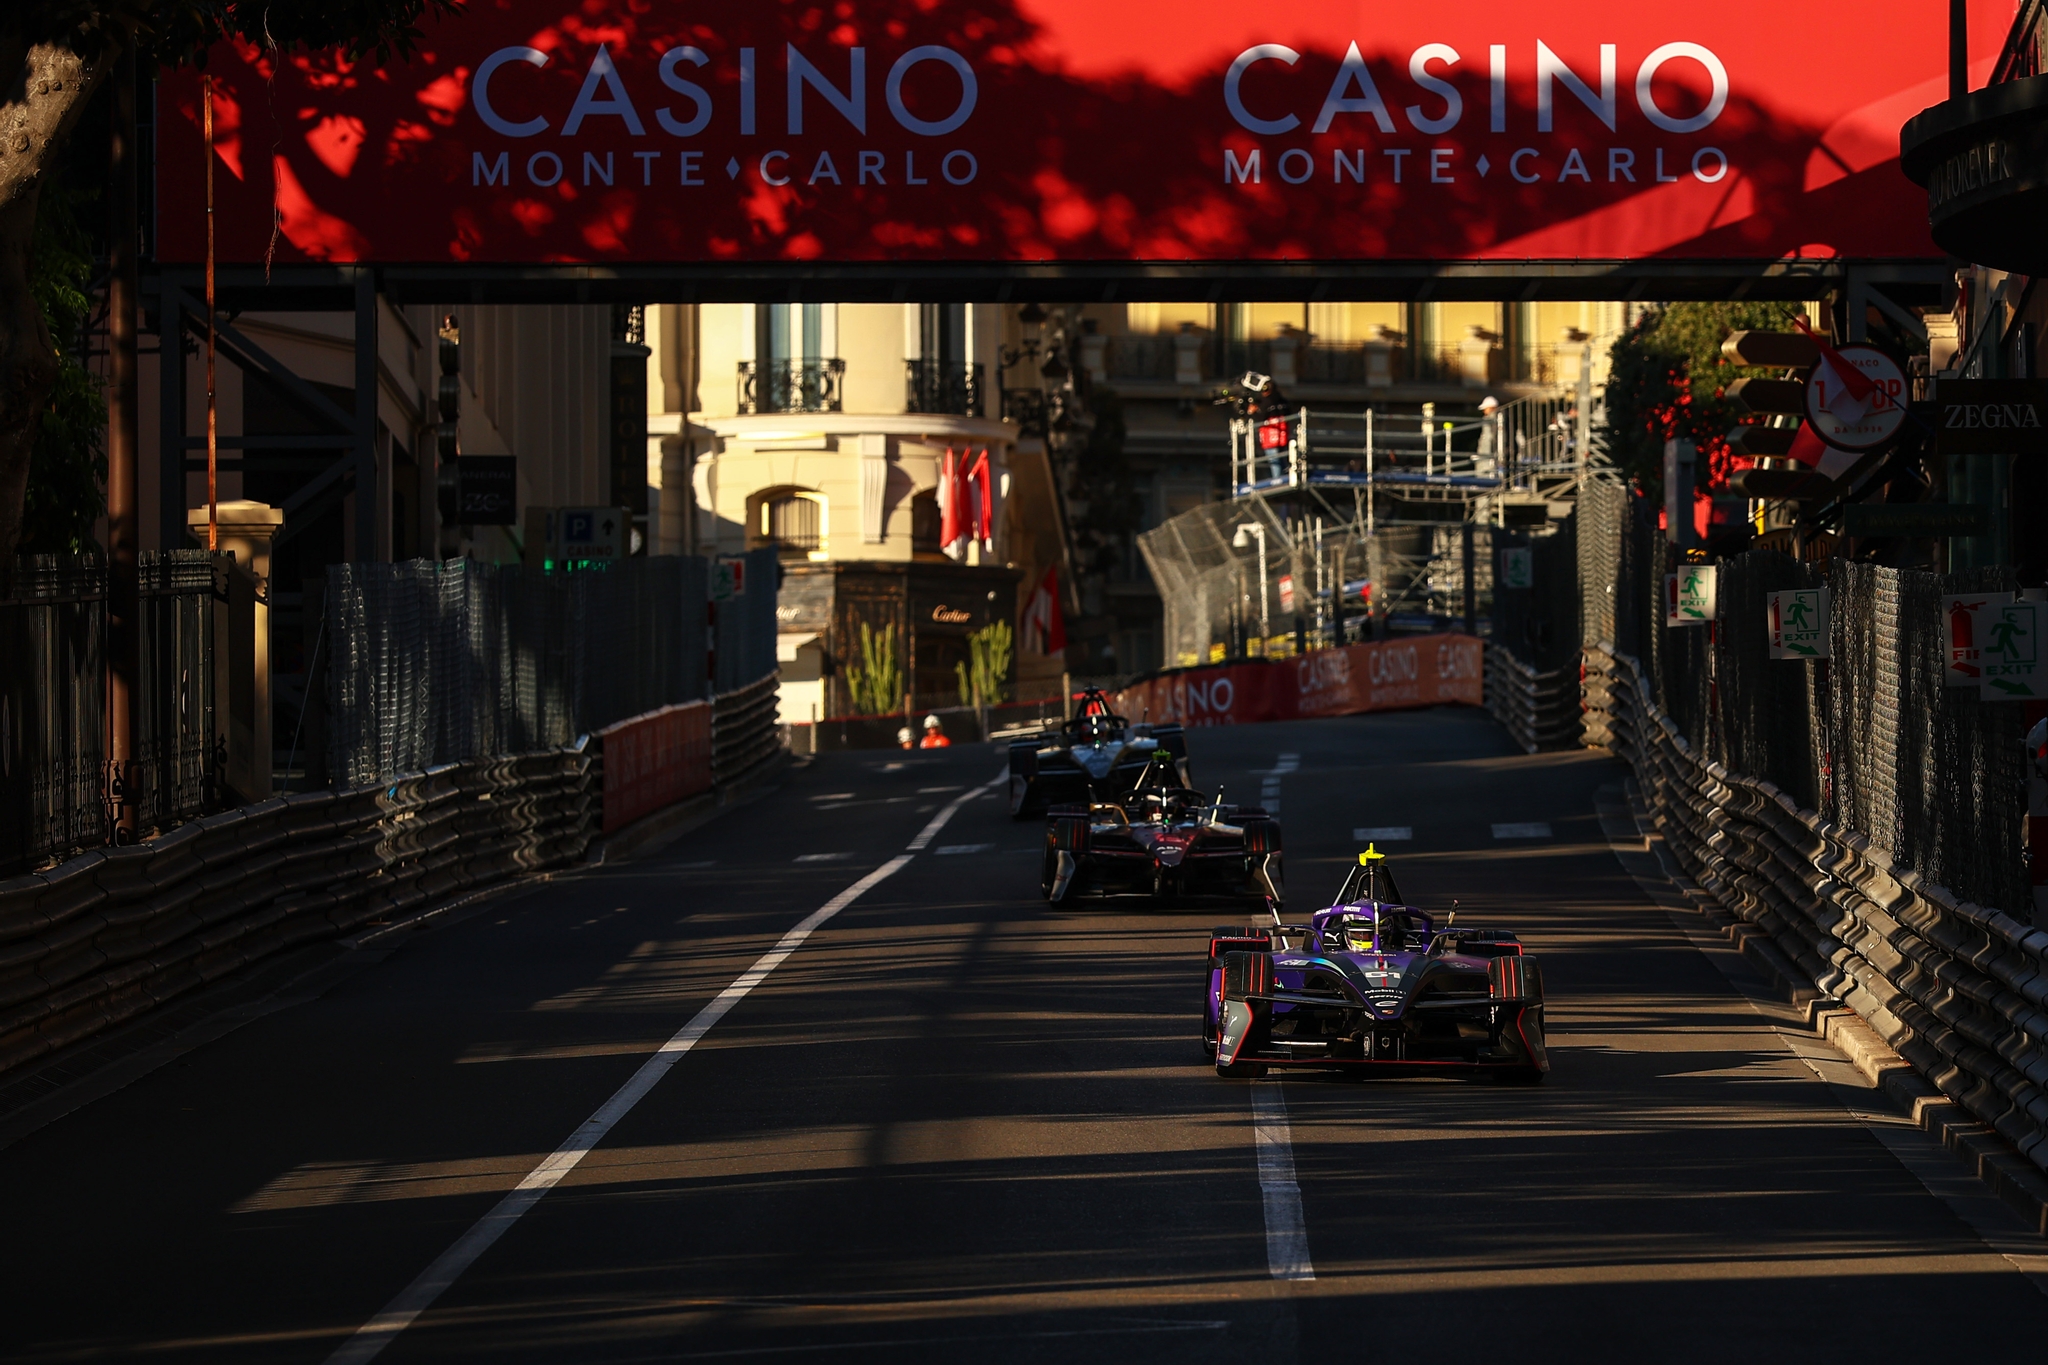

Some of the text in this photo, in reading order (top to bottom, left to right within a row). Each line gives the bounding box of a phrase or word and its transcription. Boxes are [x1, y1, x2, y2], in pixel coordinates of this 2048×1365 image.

[472, 41, 978, 137] CASINO
[1223, 38, 1729, 135] CASINO
[472, 149, 978, 187] MONTE CARLO
[1224, 146, 1728, 184] MONTE CARLO
[1946, 139, 2011, 200] FOREVER
[1944, 403, 2043, 429] ZEGNA
[572, 518, 587, 536] P
[567, 545, 613, 557] CASINO
[932, 604, 972, 624] Cartier
[1784, 633, 1820, 641] EXIT
[1368, 645, 1418, 686] CASINO
[1986, 664, 2036, 675] EXIT
